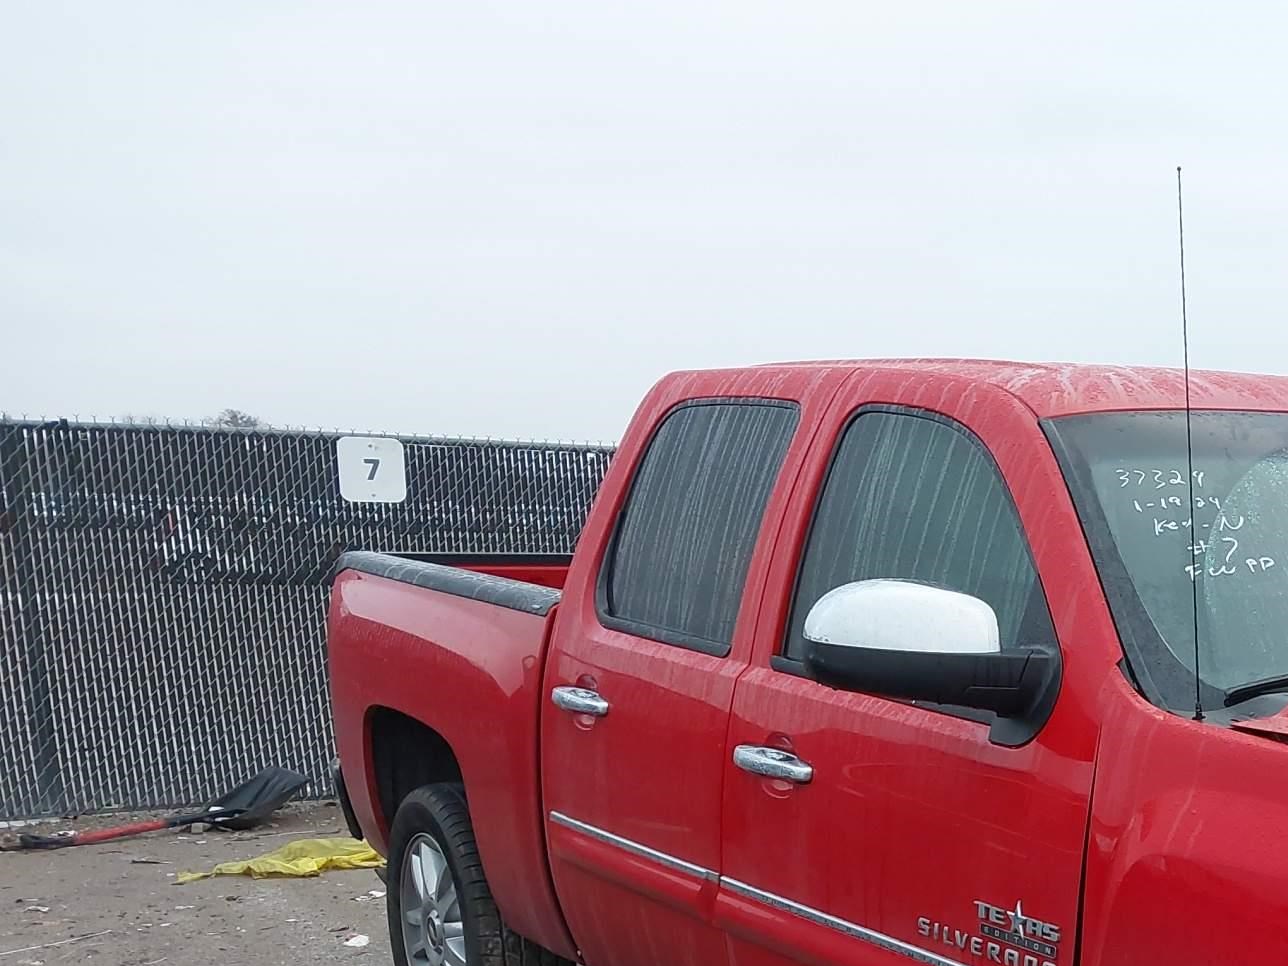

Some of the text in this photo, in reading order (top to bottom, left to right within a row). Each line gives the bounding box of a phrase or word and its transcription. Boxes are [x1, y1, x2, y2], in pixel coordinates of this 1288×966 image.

[363, 458, 381, 481] 7
[973, 899, 1061, 942] TEXAS
[982, 925, 1055, 956] EDITION
